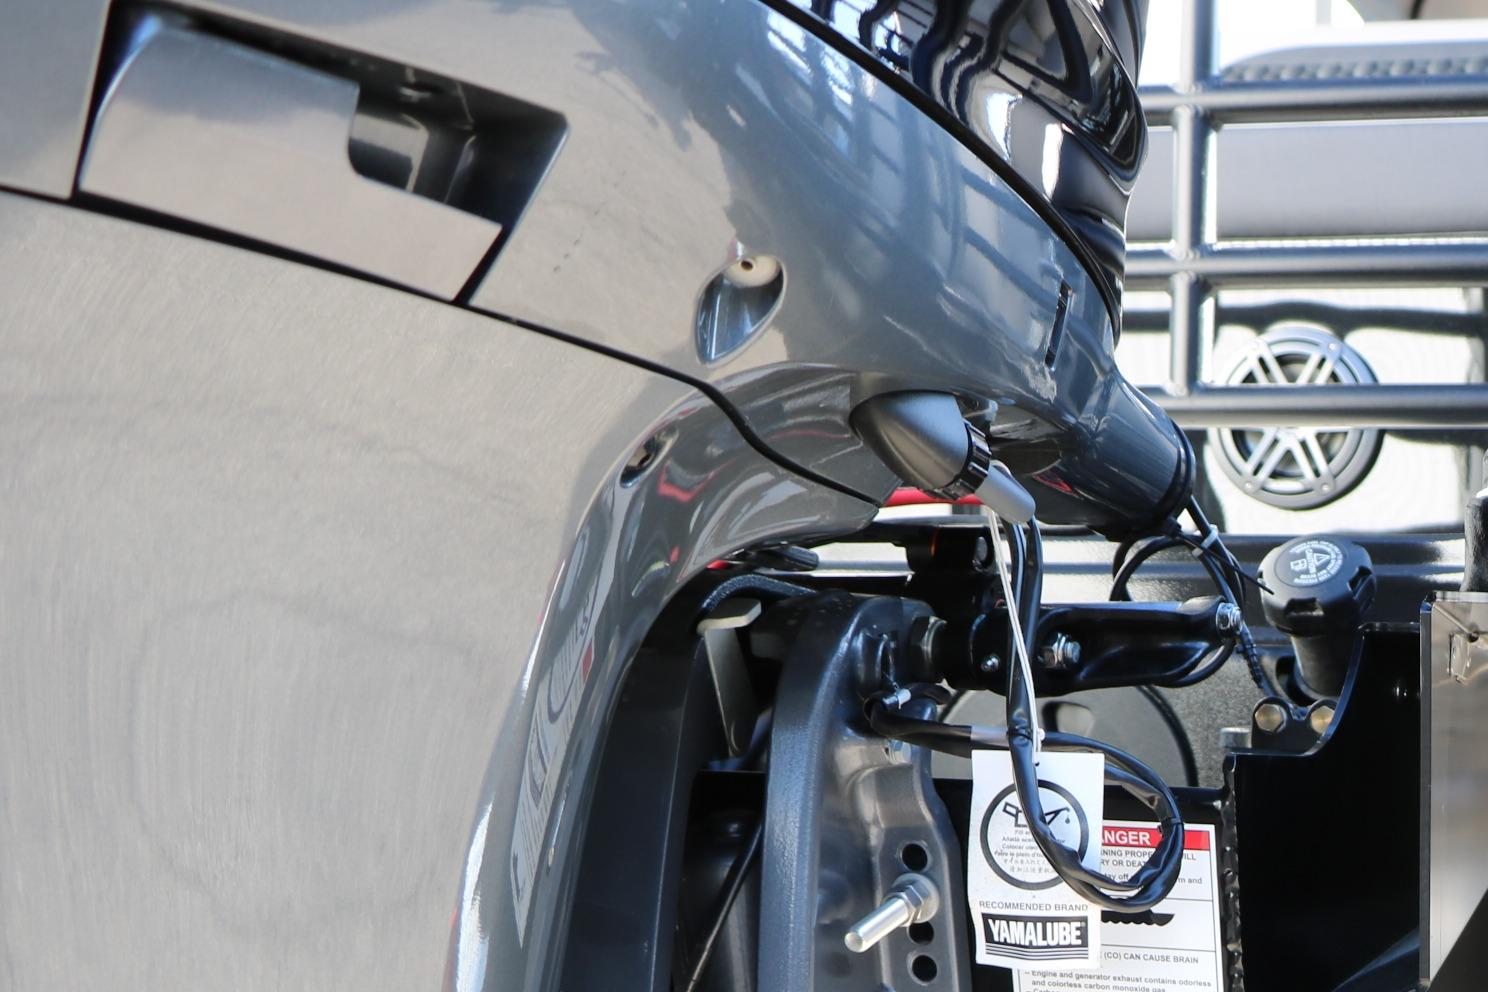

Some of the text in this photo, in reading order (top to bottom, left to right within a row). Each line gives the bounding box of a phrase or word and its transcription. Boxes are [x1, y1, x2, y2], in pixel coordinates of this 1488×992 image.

[1102, 829, 1152, 845] NGER
[1100, 849, 1122, 857] NING
[1125, 849, 1153, 858] PROPE
[1112, 859, 1124, 867] OR
[979, 900, 1089, 912] RECOMMENDED BRAND
[987, 918, 1082, 947] YAMALUBE
[1104, 951, 1199, 964] (CO) CAN CAUSE BRAIN
[1031, 970, 1057, 978] Engine
[1113, 974, 1142, 982] exhaust
[1144, 977, 1177, 985] contains
[1178, 978, 1211, 987] odorless
[1047, 980, 1082, 988] colorless
[1084, 982, 1110, 990] carbon
[1112, 984, 1150, 992] monoxide
